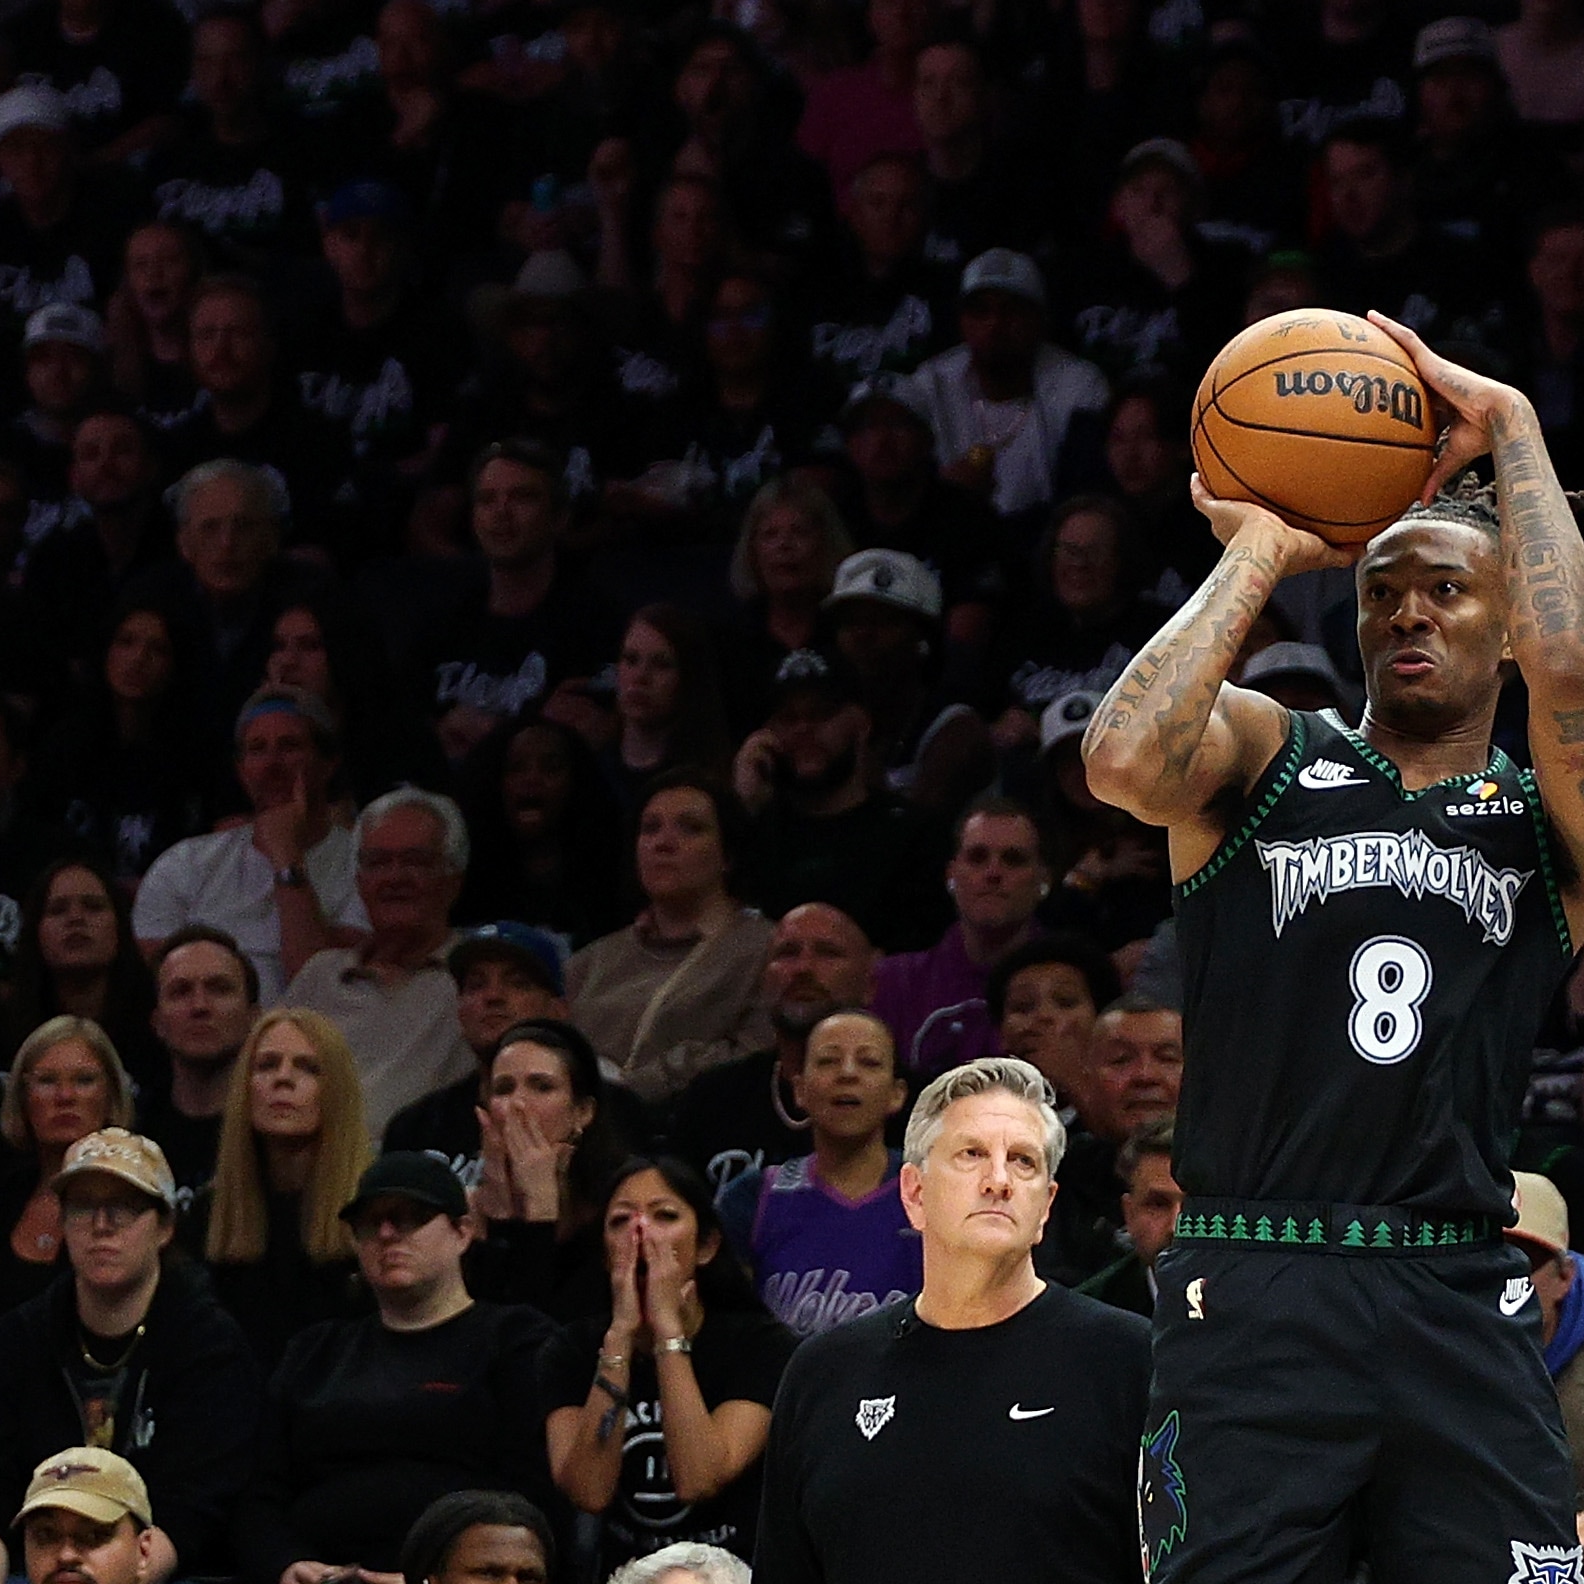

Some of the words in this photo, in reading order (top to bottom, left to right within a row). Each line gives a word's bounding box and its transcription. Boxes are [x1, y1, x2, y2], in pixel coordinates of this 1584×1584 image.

[1272, 371, 1422, 431] Wilson
[1446, 798, 1524, 818] sezzle
[1256, 829, 1535, 947] TIMBERWOLVES
[1347, 934, 1434, 1066] 8
